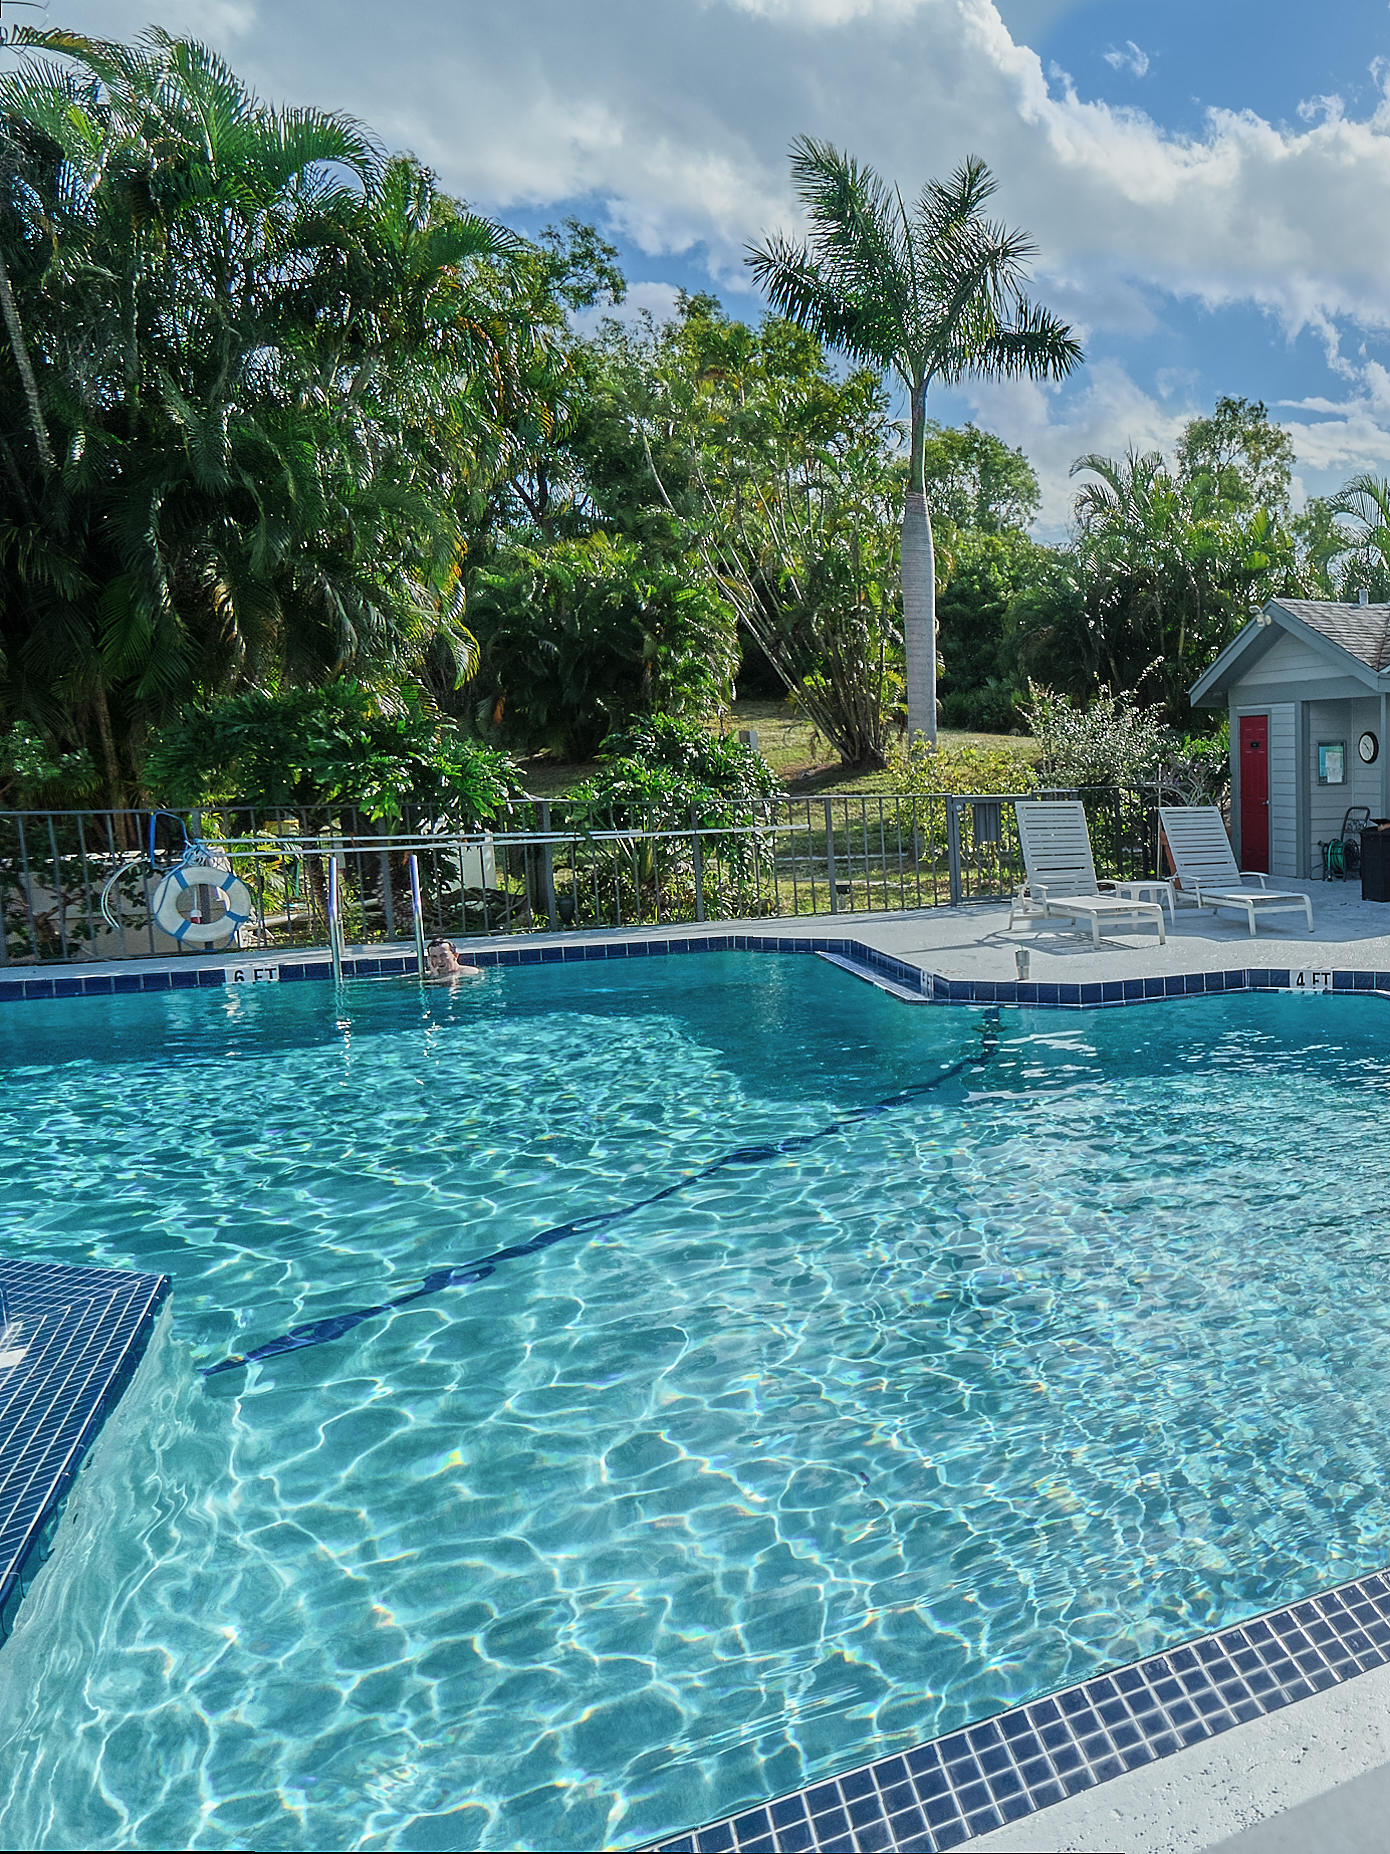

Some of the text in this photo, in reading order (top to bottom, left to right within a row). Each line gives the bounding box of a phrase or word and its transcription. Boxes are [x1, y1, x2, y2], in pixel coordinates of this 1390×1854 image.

[233, 967, 277, 982] 6 FT
[1296, 971, 1331, 987] 4 FT
